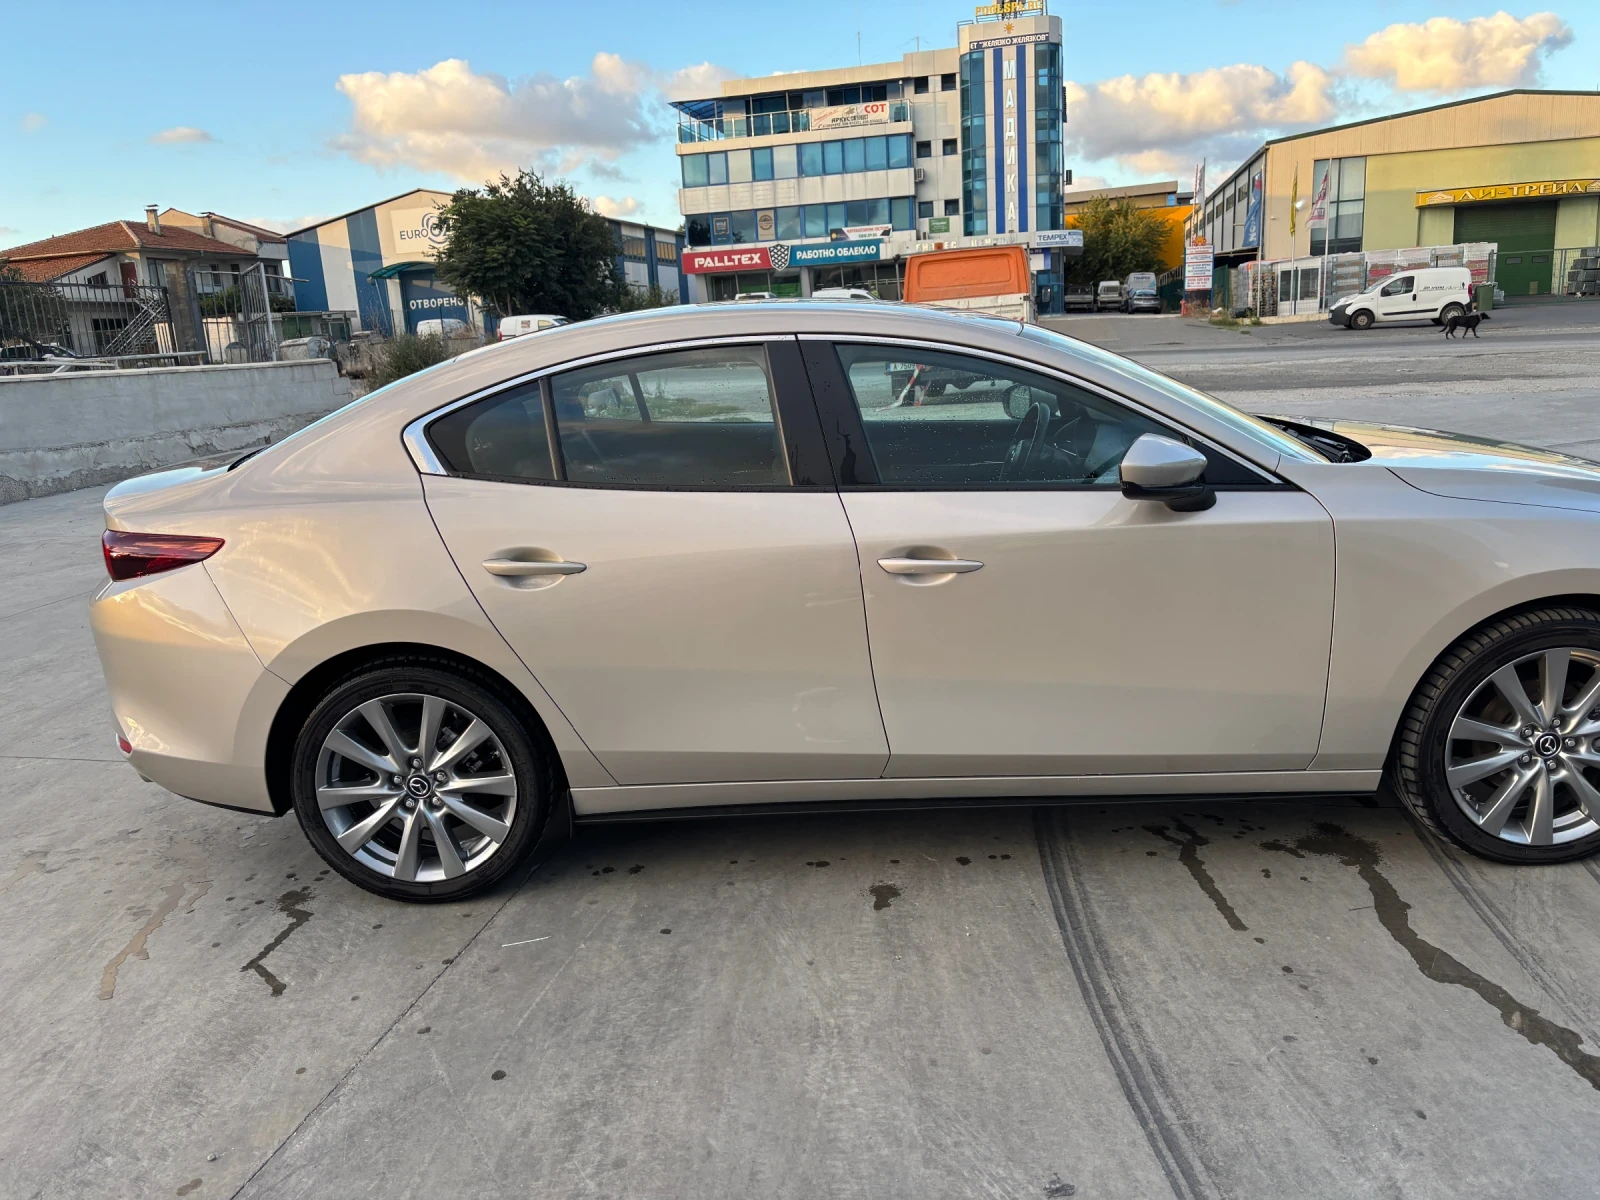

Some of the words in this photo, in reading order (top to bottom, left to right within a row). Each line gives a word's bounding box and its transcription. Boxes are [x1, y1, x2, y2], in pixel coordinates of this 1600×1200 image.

[864, 103, 886, 114] СОТ
[1003, 59, 1017, 221] МАДИКА
[1457, 181, 1584, 202] ДИ-ТРЕЙД
[1037, 233, 1068, 242] TEMPEX
[796, 248, 835, 260] РАБОТНО
[836, 245, 877, 257] ОБЛЕКЛО
[694, 253, 762, 269] PALLTEX
[410, 297, 464, 310] ОТВОРЕНО
